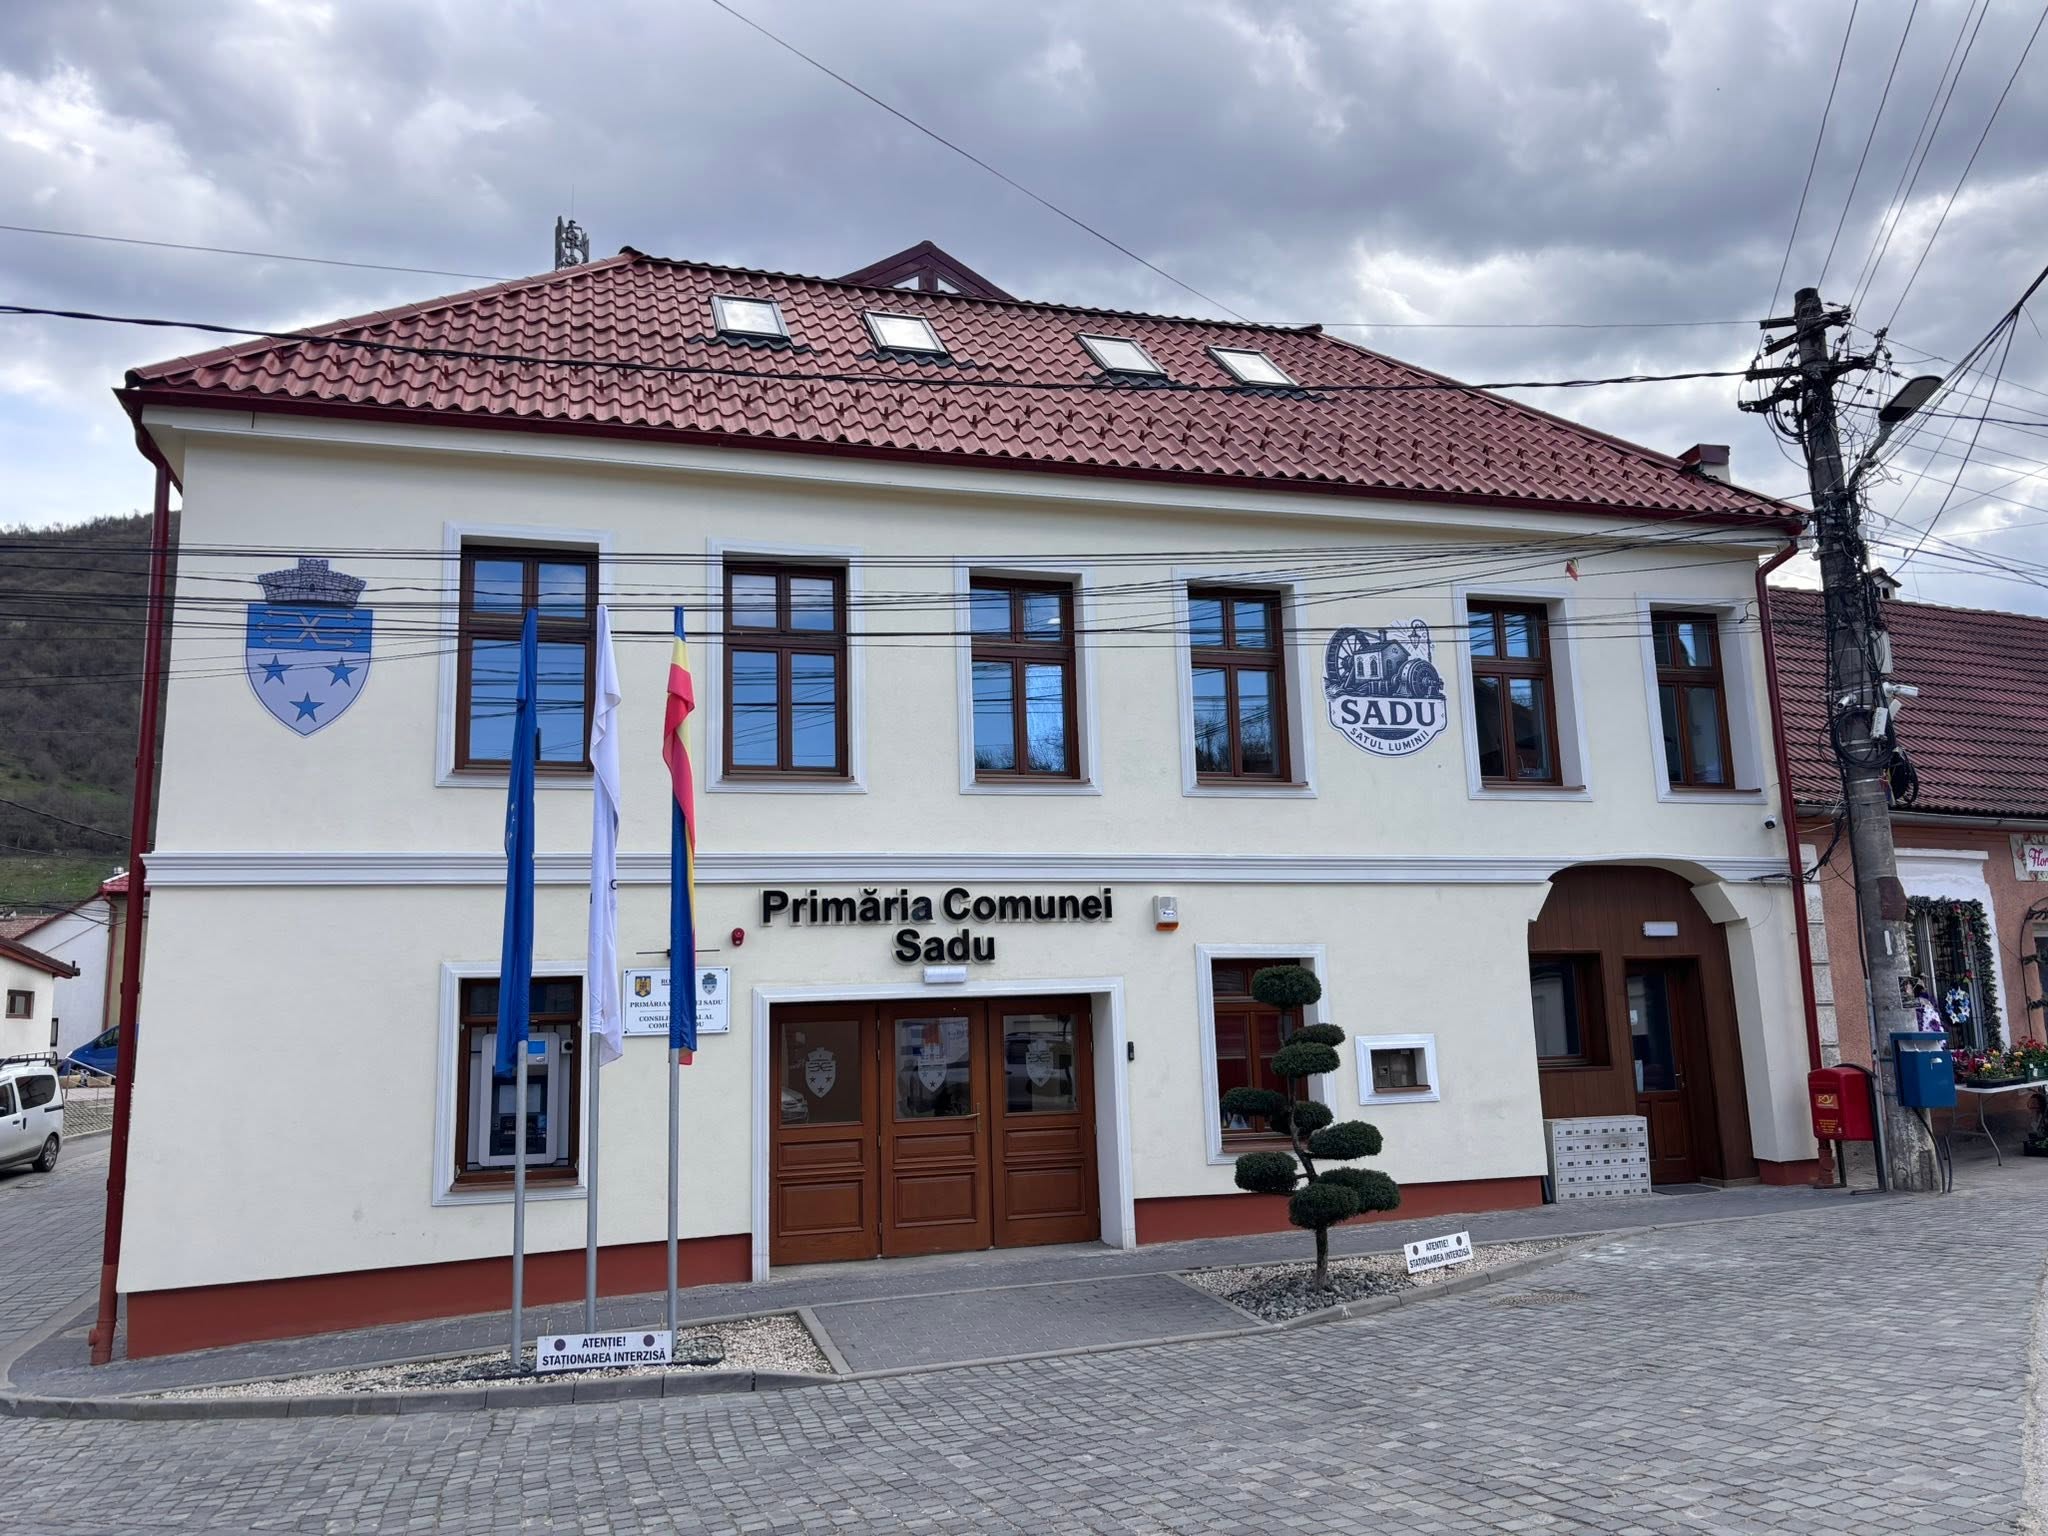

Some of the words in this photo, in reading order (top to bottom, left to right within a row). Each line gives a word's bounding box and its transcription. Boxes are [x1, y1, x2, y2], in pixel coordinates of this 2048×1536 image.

[1341, 699, 1436, 727] SADU
[1350, 727, 1384, 751] SATUL
[1388, 730, 1430, 752] LUMINII
[761, 888, 935, 925] Primăria
[942, 887, 1113, 922] Comunei
[893, 928, 996, 963] Sadu
[629, 1000, 667, 1008] PRIMĂRIA
[581, 1336, 626, 1349] ATENȚIE!
[542, 1352, 612, 1367] STAȚIONAREA
[614, 1348, 666, 1362] INTERZISĂ
